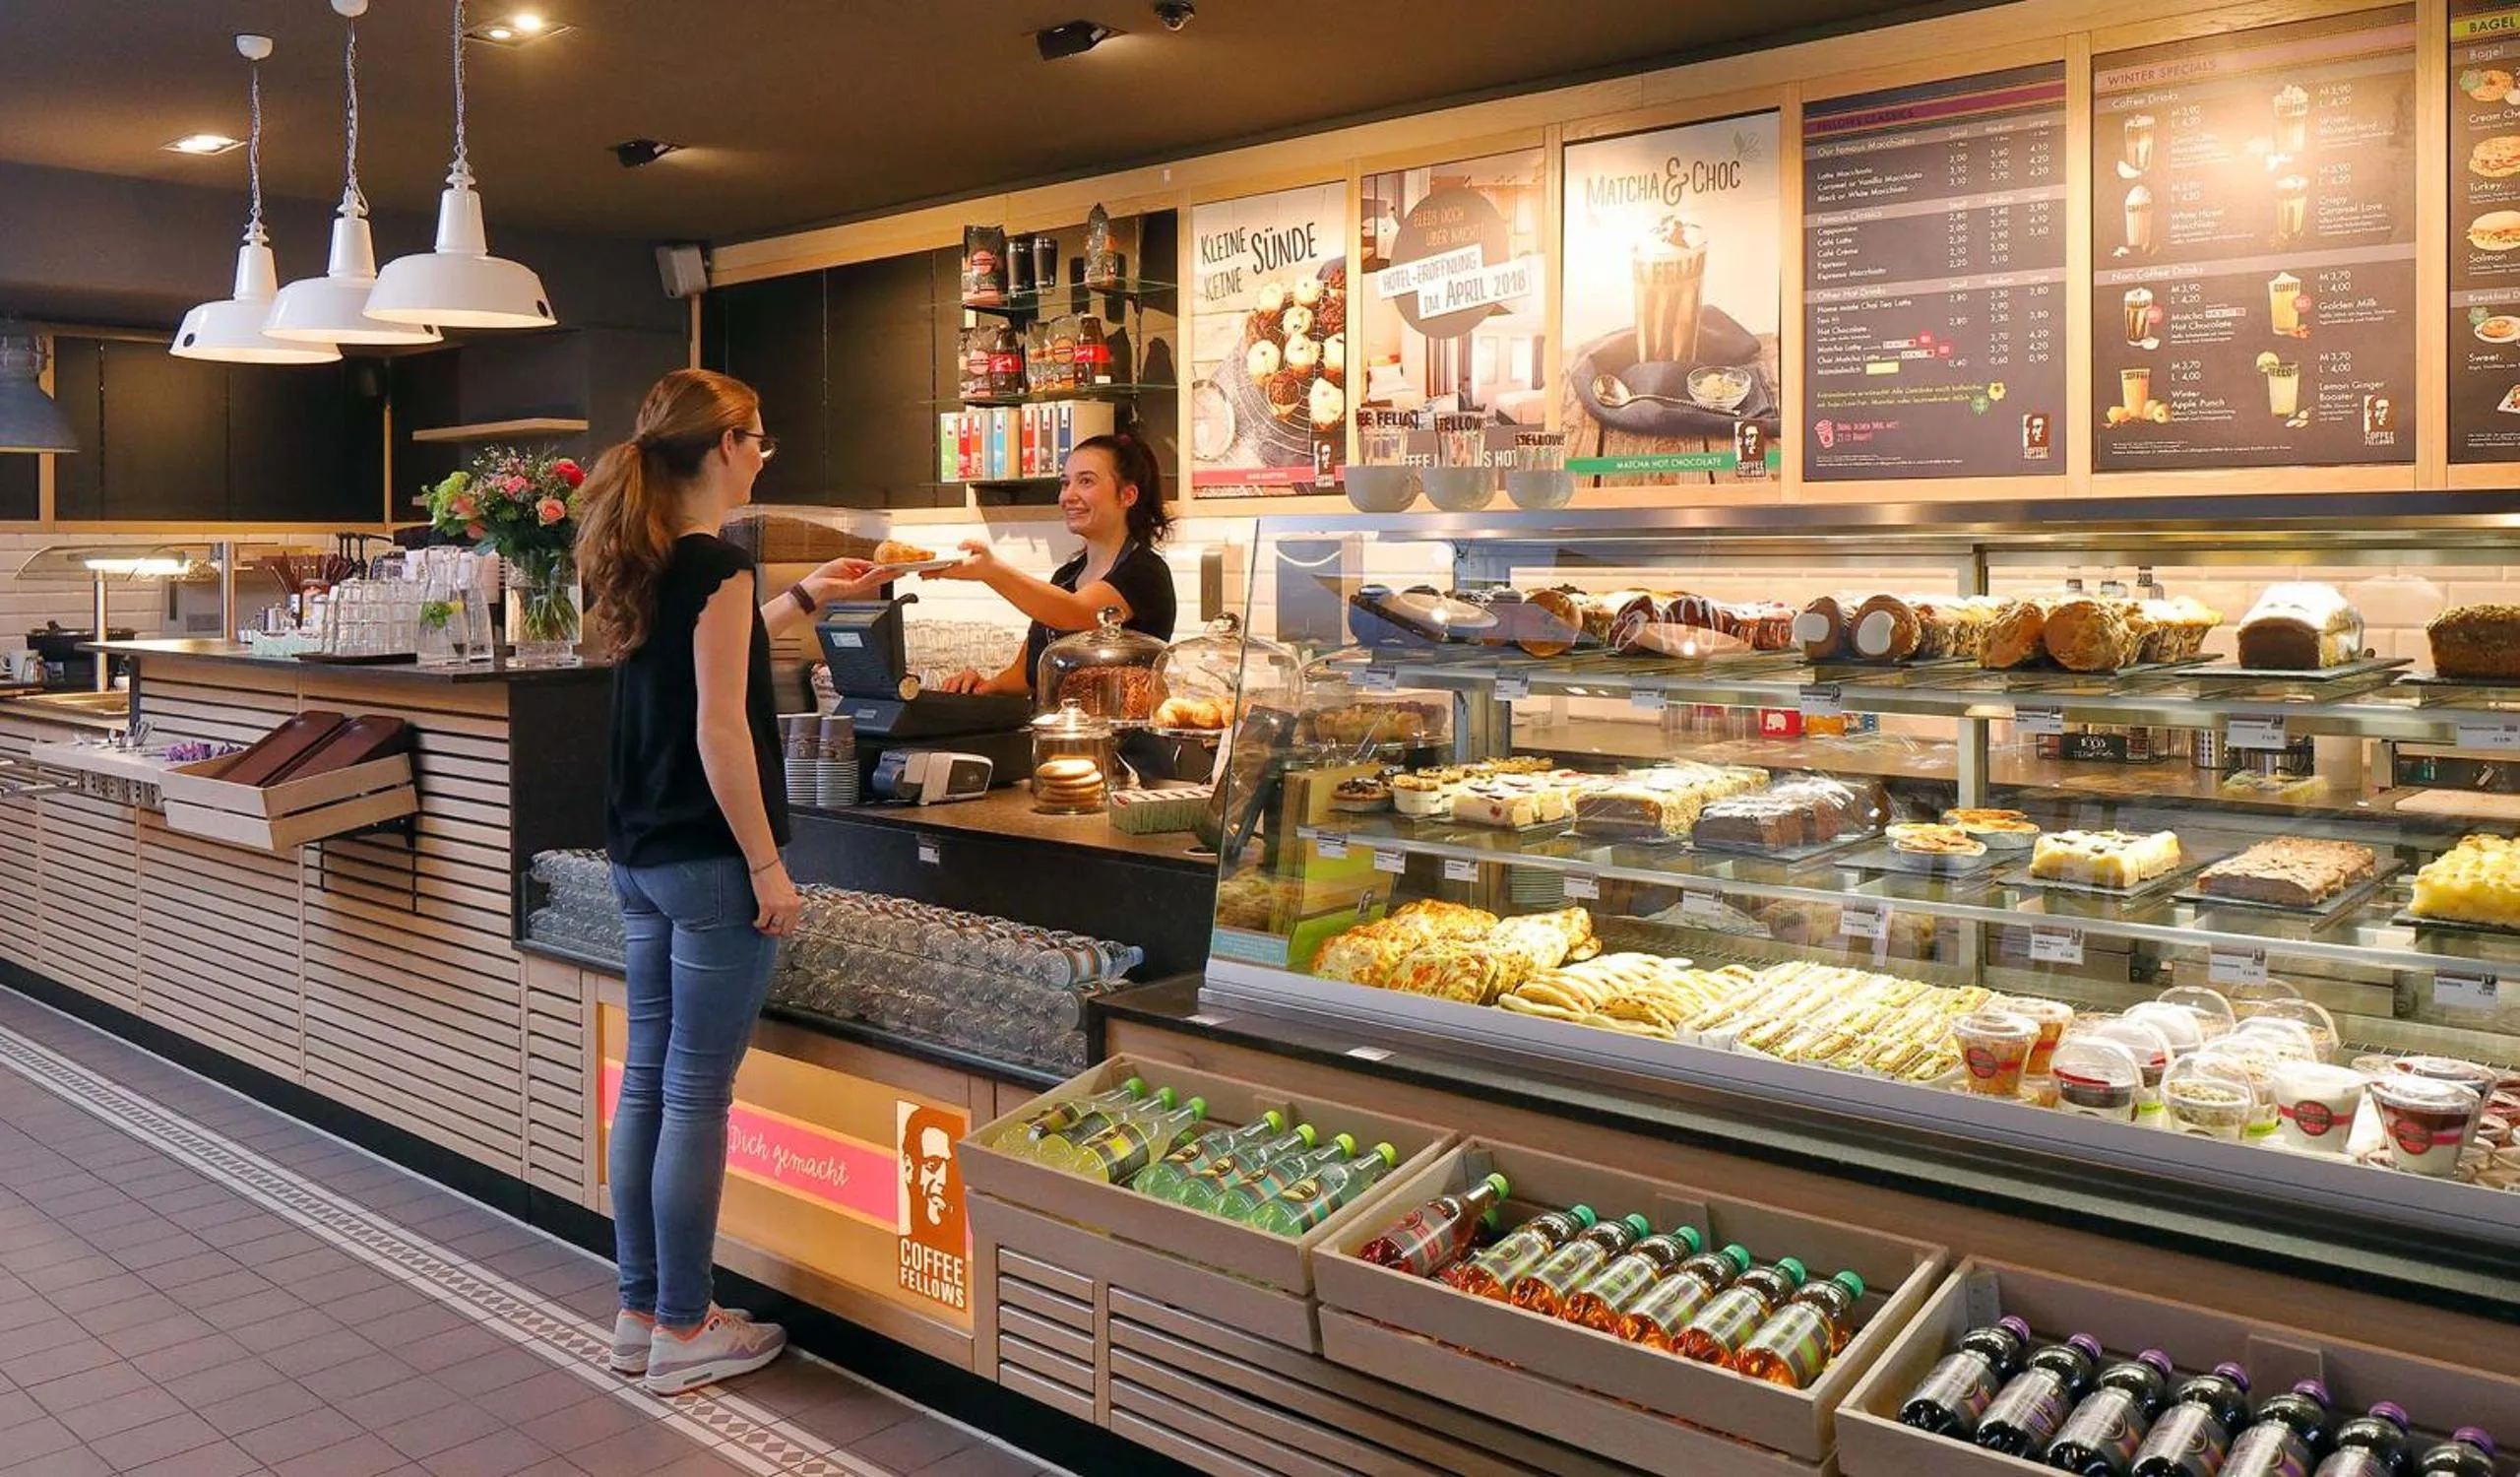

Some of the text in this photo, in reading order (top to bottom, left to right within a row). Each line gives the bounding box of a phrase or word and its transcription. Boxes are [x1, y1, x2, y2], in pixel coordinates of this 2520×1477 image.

[2469, 45, 2504, 61] Bagel
[2107, 60, 2217, 86] WINTER SPECIALS
[2111, 89, 2178, 108] Coffee Drinks
[2469, 113, 2501, 124] Cream
[1663, 157, 1689, 206] &
[1692, 160, 1740, 194] CHOC
[2469, 180, 2502, 192] Turkey
[1201, 223, 1317, 276] KLEINE SÜNDE
[2469, 252, 2507, 263] Salmon
[2137, 266, 2170, 281] Coffee
[2172, 265, 2204, 276] Drinks
[1204, 268, 1242, 301] KEINE
[1446, 277, 1487, 308] APRIL
[1493, 268, 1527, 296] 2018
[1818, 305, 1838, 314] Home
[1860, 300, 1877, 310] Chai
[1879, 299, 1892, 308] Tea
[1894, 298, 1913, 307] Latte
[2318, 297, 2378, 311] Golden Milk
[1817, 326, 1830, 336] Hot
[1832, 325, 1867, 335] Chocolate
[2172, 319, 2232, 331] Hot Chocolate
[1818, 355, 1833, 365] Chai
[2468, 353, 2500, 362] Sweet
[2319, 380, 2385, 392] Lemon Ginger
[2172, 397, 2226, 410] Apple Punch
[2319, 393, 2354, 402] Booster
[1616, 456, 1722, 471] MATCHA HOT CHOCOLATE
[1736, 460, 1765, 471] COFFEE
[729, 1124, 850, 1188] Dich gemacht
[900, 1237, 964, 1287] COFFEE
[900, 1270, 965, 1309] FELLOWS
